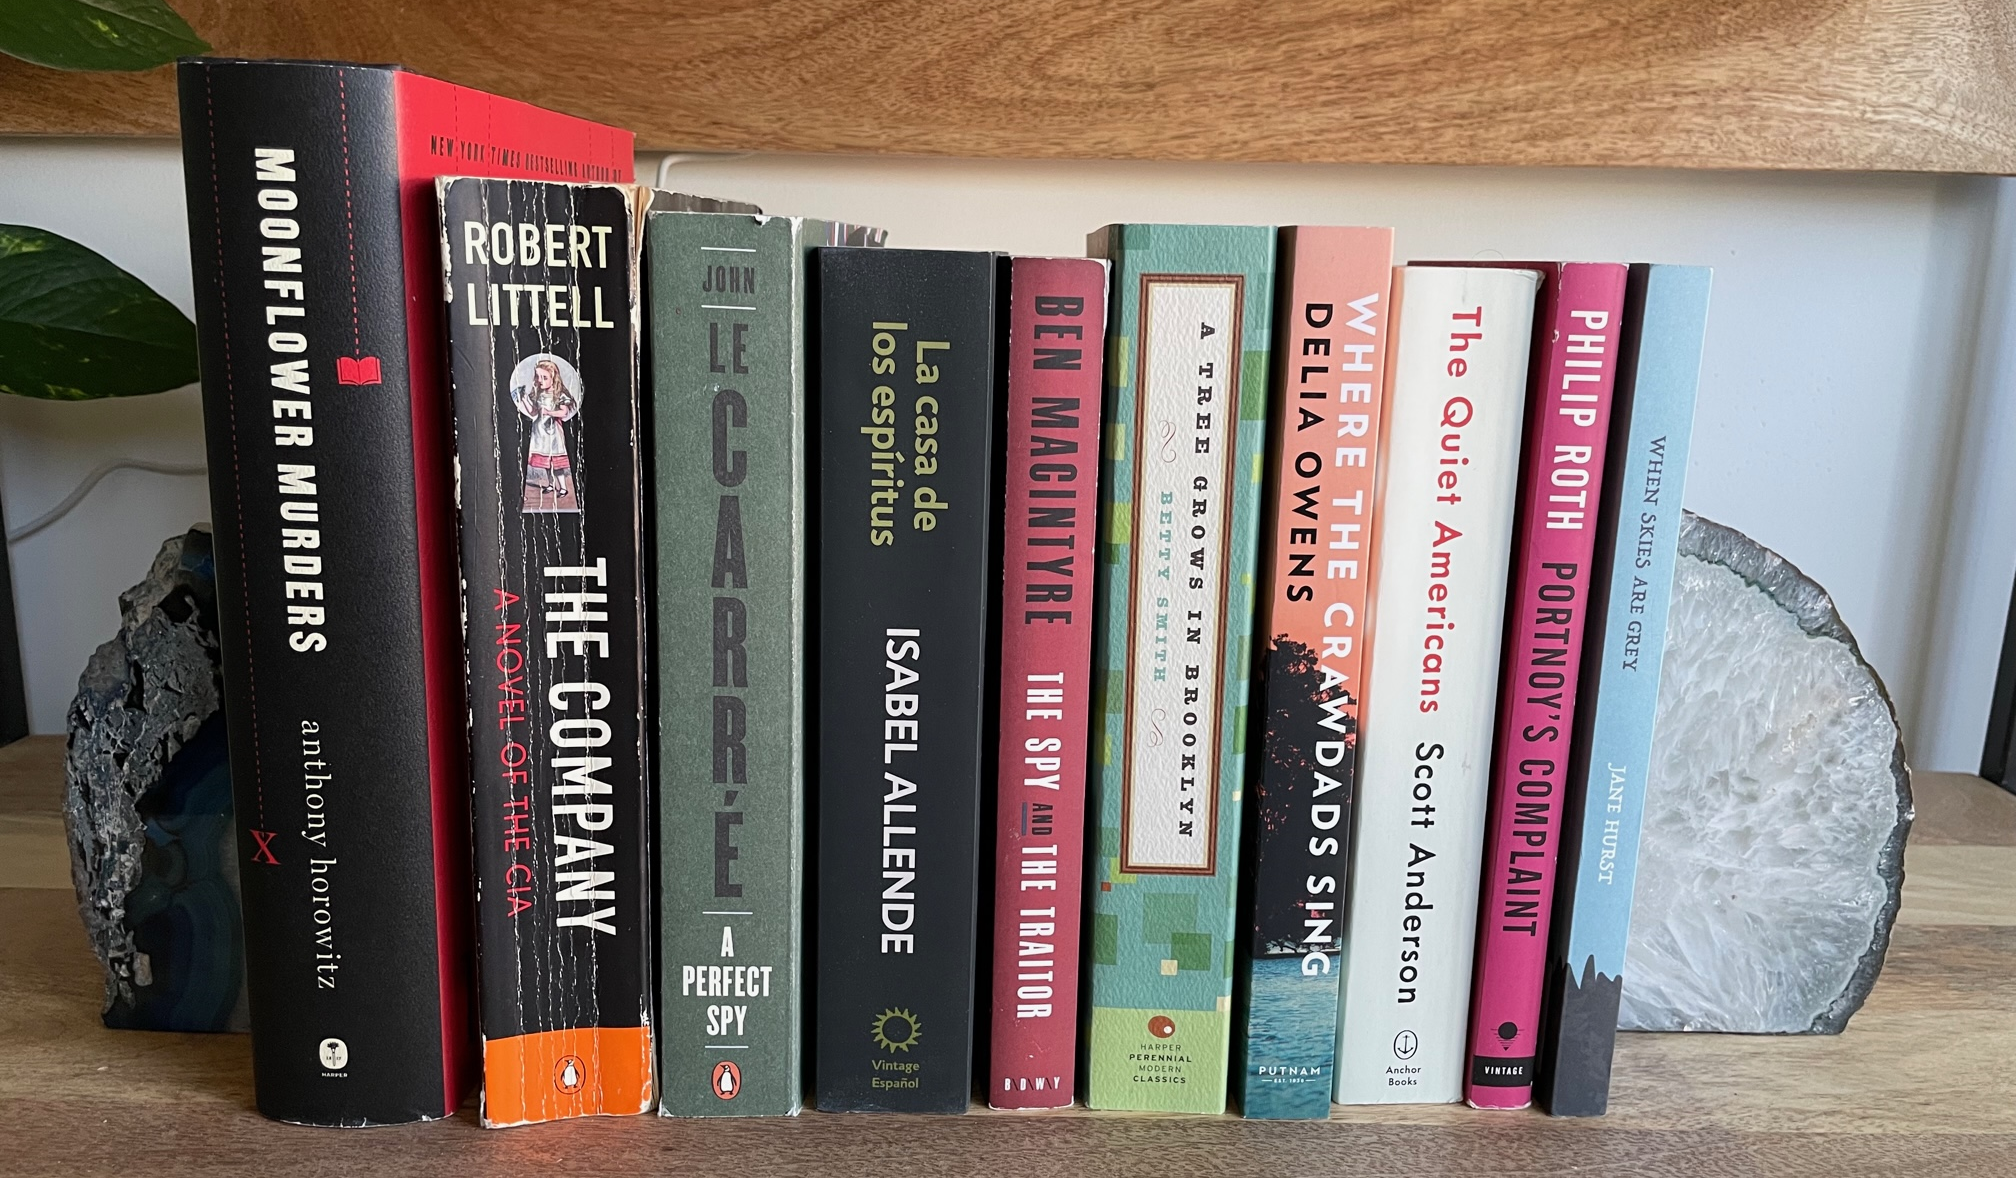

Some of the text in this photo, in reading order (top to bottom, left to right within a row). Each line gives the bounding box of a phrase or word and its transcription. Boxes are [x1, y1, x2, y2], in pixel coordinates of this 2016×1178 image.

[431, 135, 454, 157] NEW
[461, 141, 485, 163] YORK
[491, 147, 520, 168] TIMES
[525, 153, 577, 177] BESTSELLING
[464, 221, 613, 269] ROBERT
[467, 283, 614, 328] LITTELL
[703, 264, 755, 294] JOHN
[253, 147, 327, 653] MOONFLOWER MURDERS
[709, 323, 749, 374] LE
[861, 321, 908, 547] los espíritus
[913, 341, 951, 532] La casa de
[1024, 295, 1084, 626] BEN MACINTYRE
[1286, 303, 1333, 602] DELIA OWENS
[1546, 310, 1608, 530] PHILIP ROTH
[1419, 306, 1482, 714] The Quiet Americans
[1622, 435, 1667, 672] WHEN SKIES ARE GREY
[1154, 491, 1173, 682] BETTY SMITH
[1178, 321, 1216, 837] A TREE GROWS IN BROOKLYN
[1301, 293, 1379, 977] WHERE THE CRAWDADS SING
[493, 588, 532, 917] A NOVEL OF THE CIA
[543, 558, 617, 936] THE COMPANY
[881, 627, 920, 954] ISABEL ALLENDE
[301, 720, 341, 990] anthony horowitz
[1016, 672, 1064, 1020] THE SPY AND THE TRAITOR
[1397, 742, 1444, 1004] Scott Anderson
[1502, 761, 1556, 937] COMPLAINT
[1598, 762, 1626, 886] JANE HURST
[682, 966, 772, 998] PERFECT
[720, 926, 734, 958] A
[706, 1005, 748, 1037] SPY
[871, 1058, 920, 1074] Vintage
[871, 1074, 920, 1089] Español
[1129, 1053, 1192, 1062] PERENNIAL
[1133, 1075, 1186, 1084] CLASSICS
[1139, 1064, 1182, 1073] MODERN
[1141, 1043, 1182, 1052] HARPER
[1258, 1066, 1321, 1076] PUTNAM
[1385, 1064, 1422, 1075] Anchor
[1388, 1077, 1418, 1087] Books
[1484, 1066, 1524, 1076] VINTAGE
